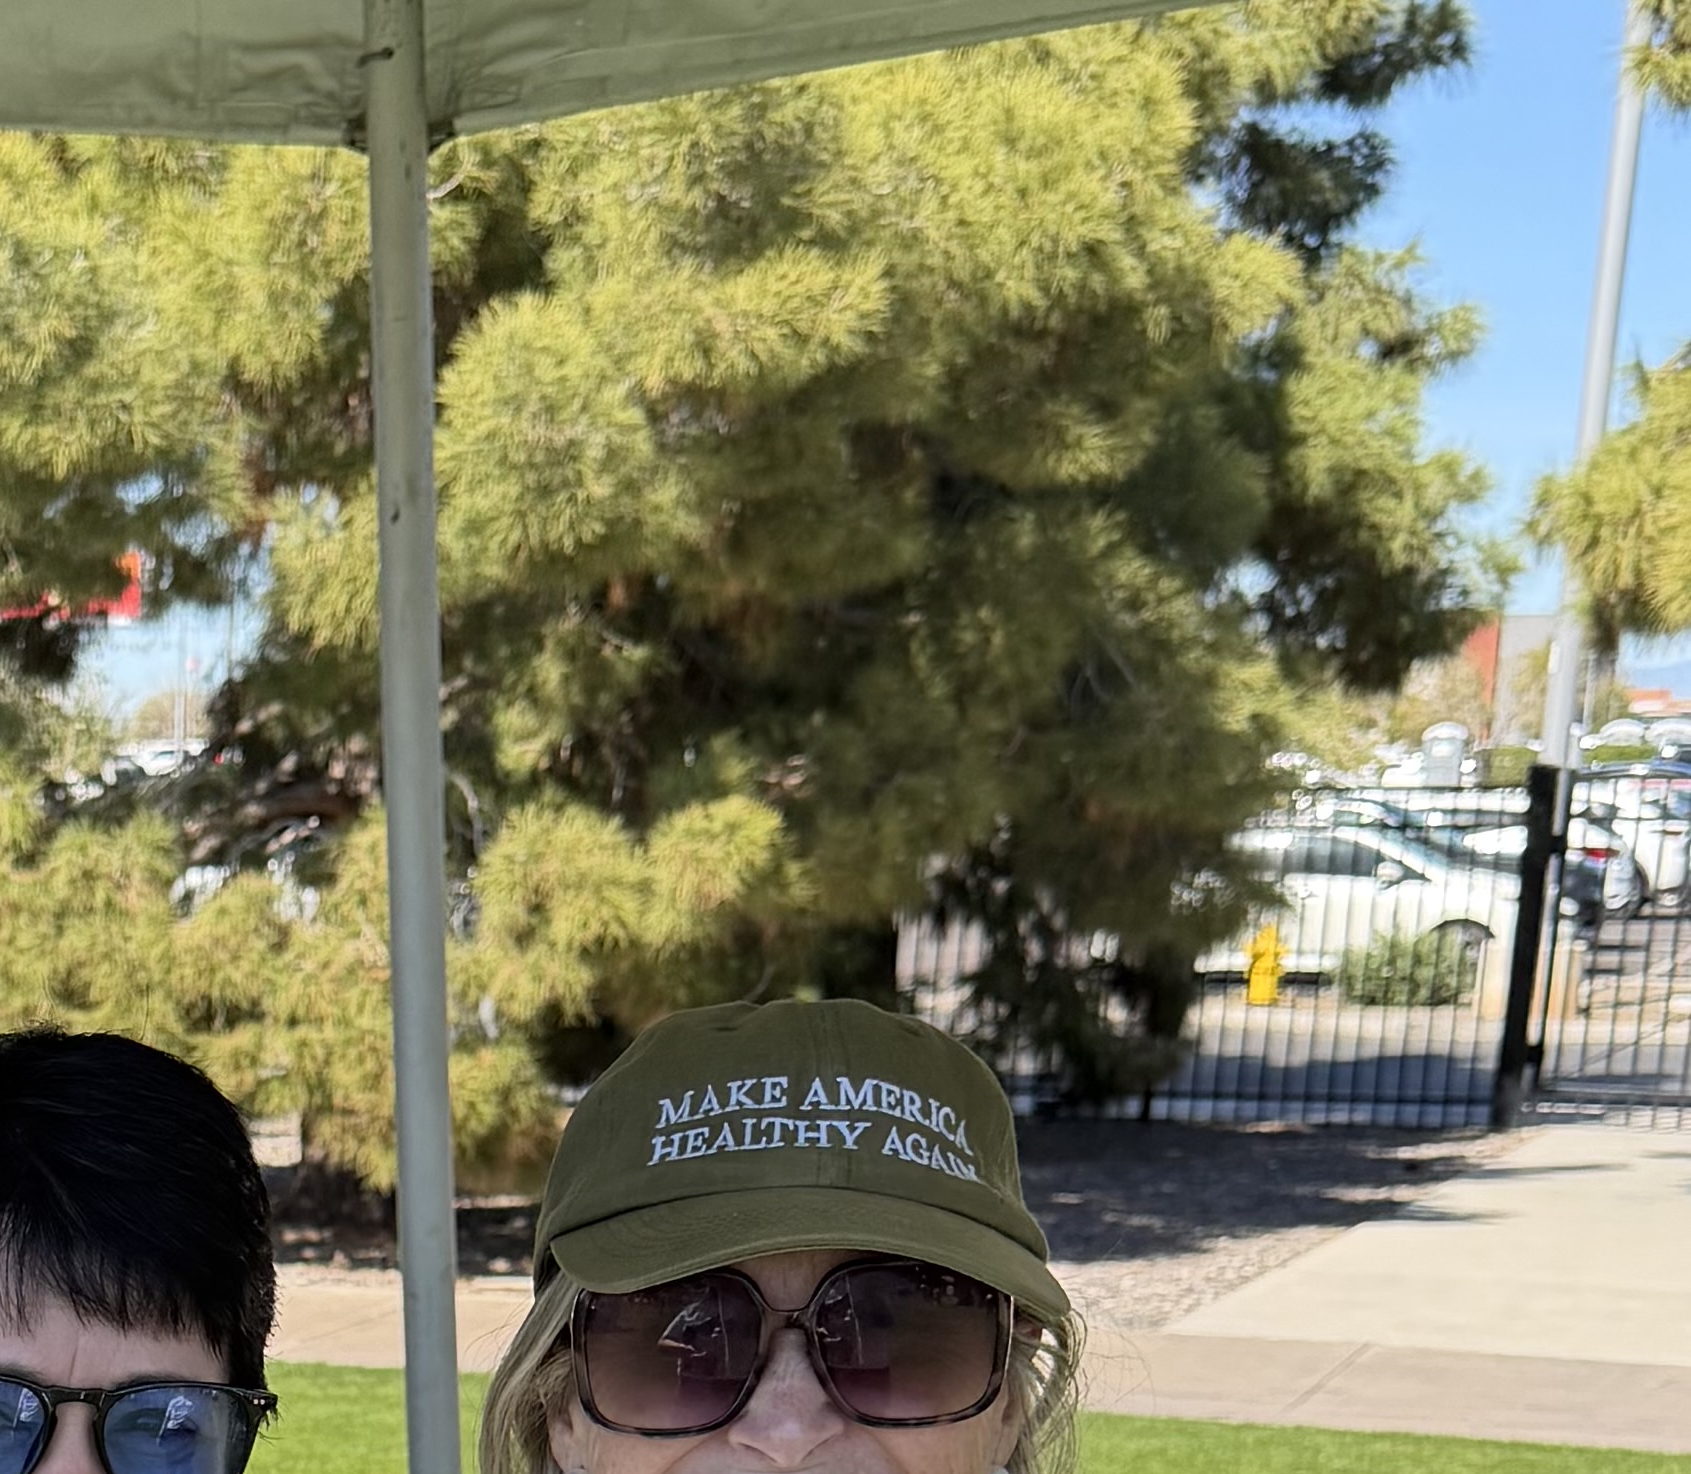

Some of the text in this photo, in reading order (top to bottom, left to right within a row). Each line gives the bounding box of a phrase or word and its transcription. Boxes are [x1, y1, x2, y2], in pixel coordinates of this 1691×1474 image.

[646, 1117, 872, 1167] HEALTHY
[655, 1076, 975, 1157] MAKE AMERICA
